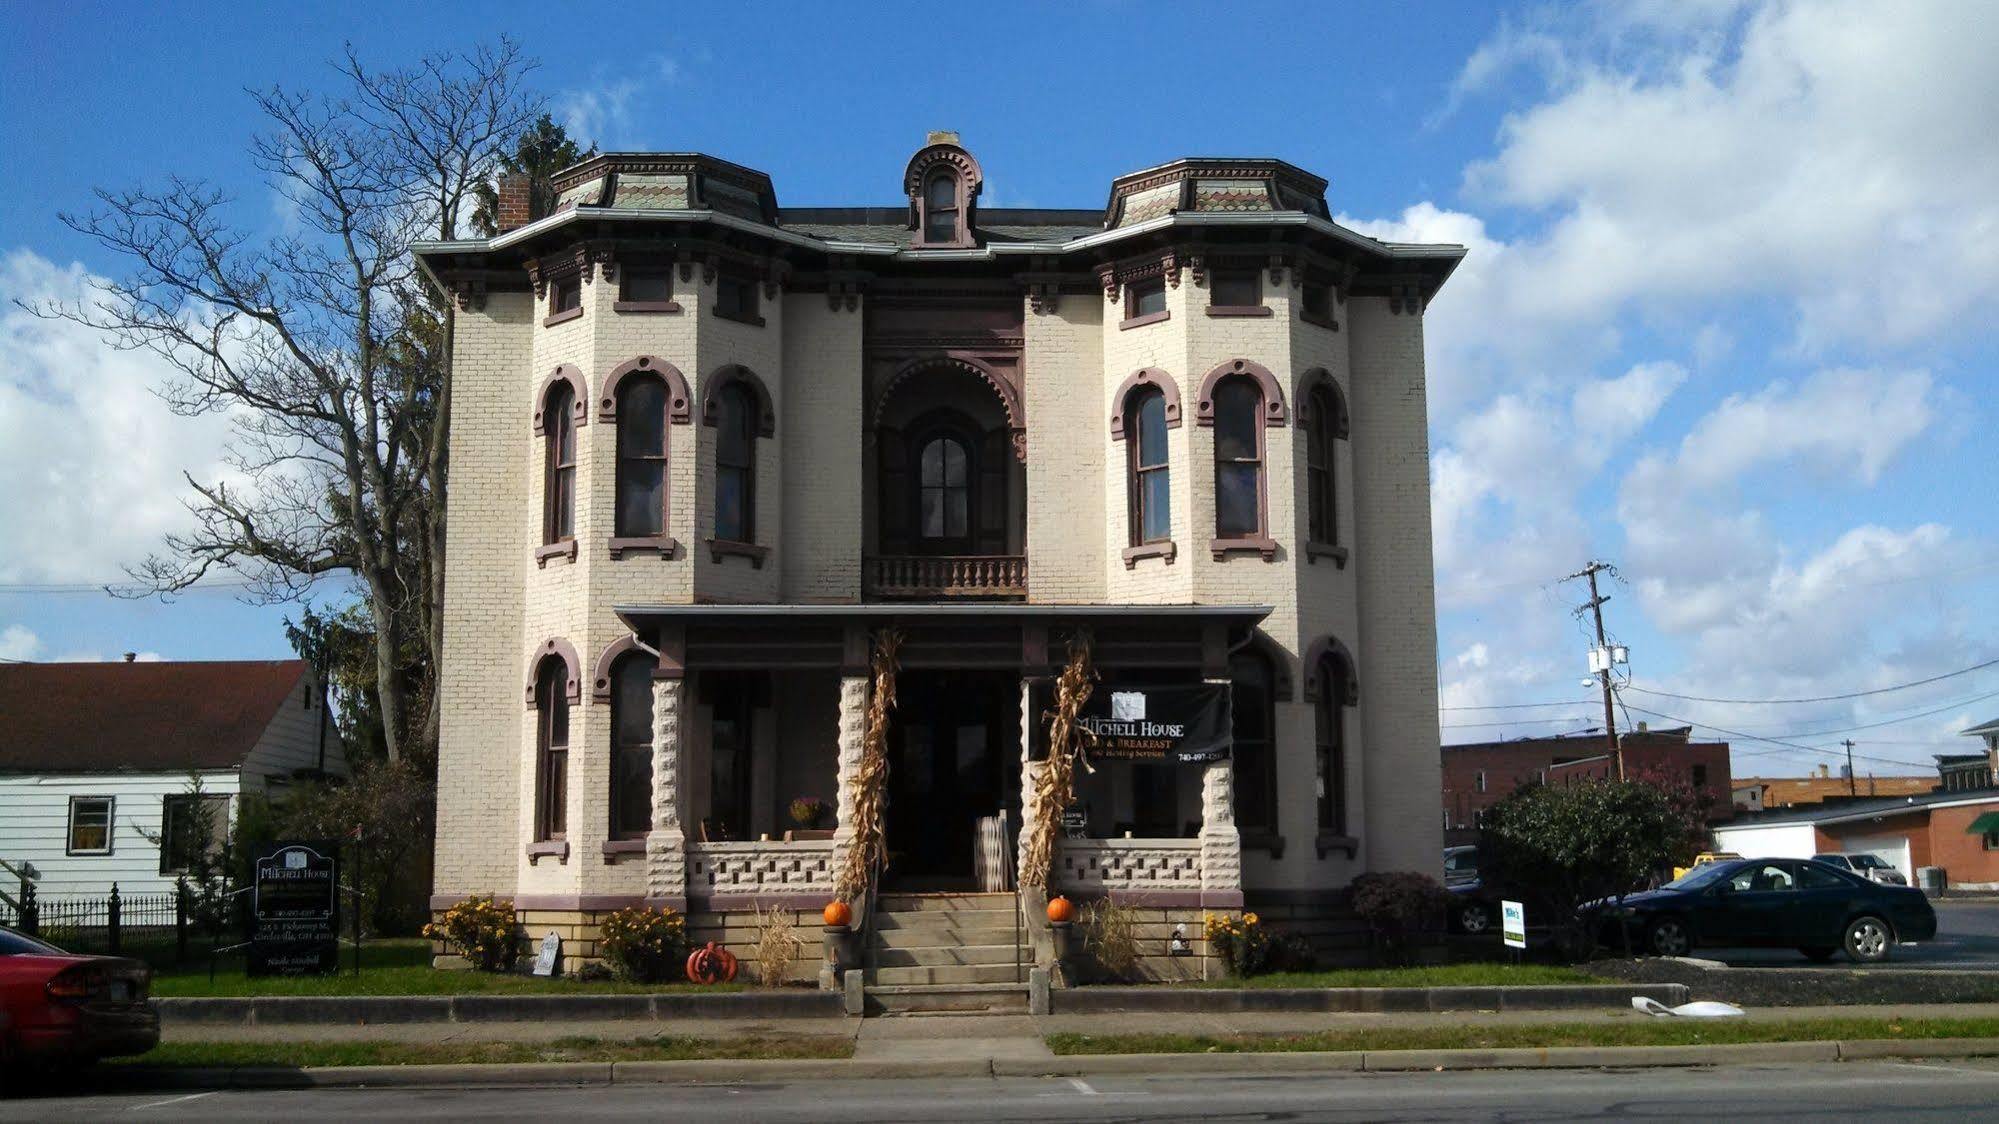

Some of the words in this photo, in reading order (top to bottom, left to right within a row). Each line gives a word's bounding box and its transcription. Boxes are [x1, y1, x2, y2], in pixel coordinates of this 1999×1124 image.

[1140, 721, 1184, 737] HOUSE
[1106, 740, 1114, 748] &
[1117, 740, 1172, 749] BREAKFAST
